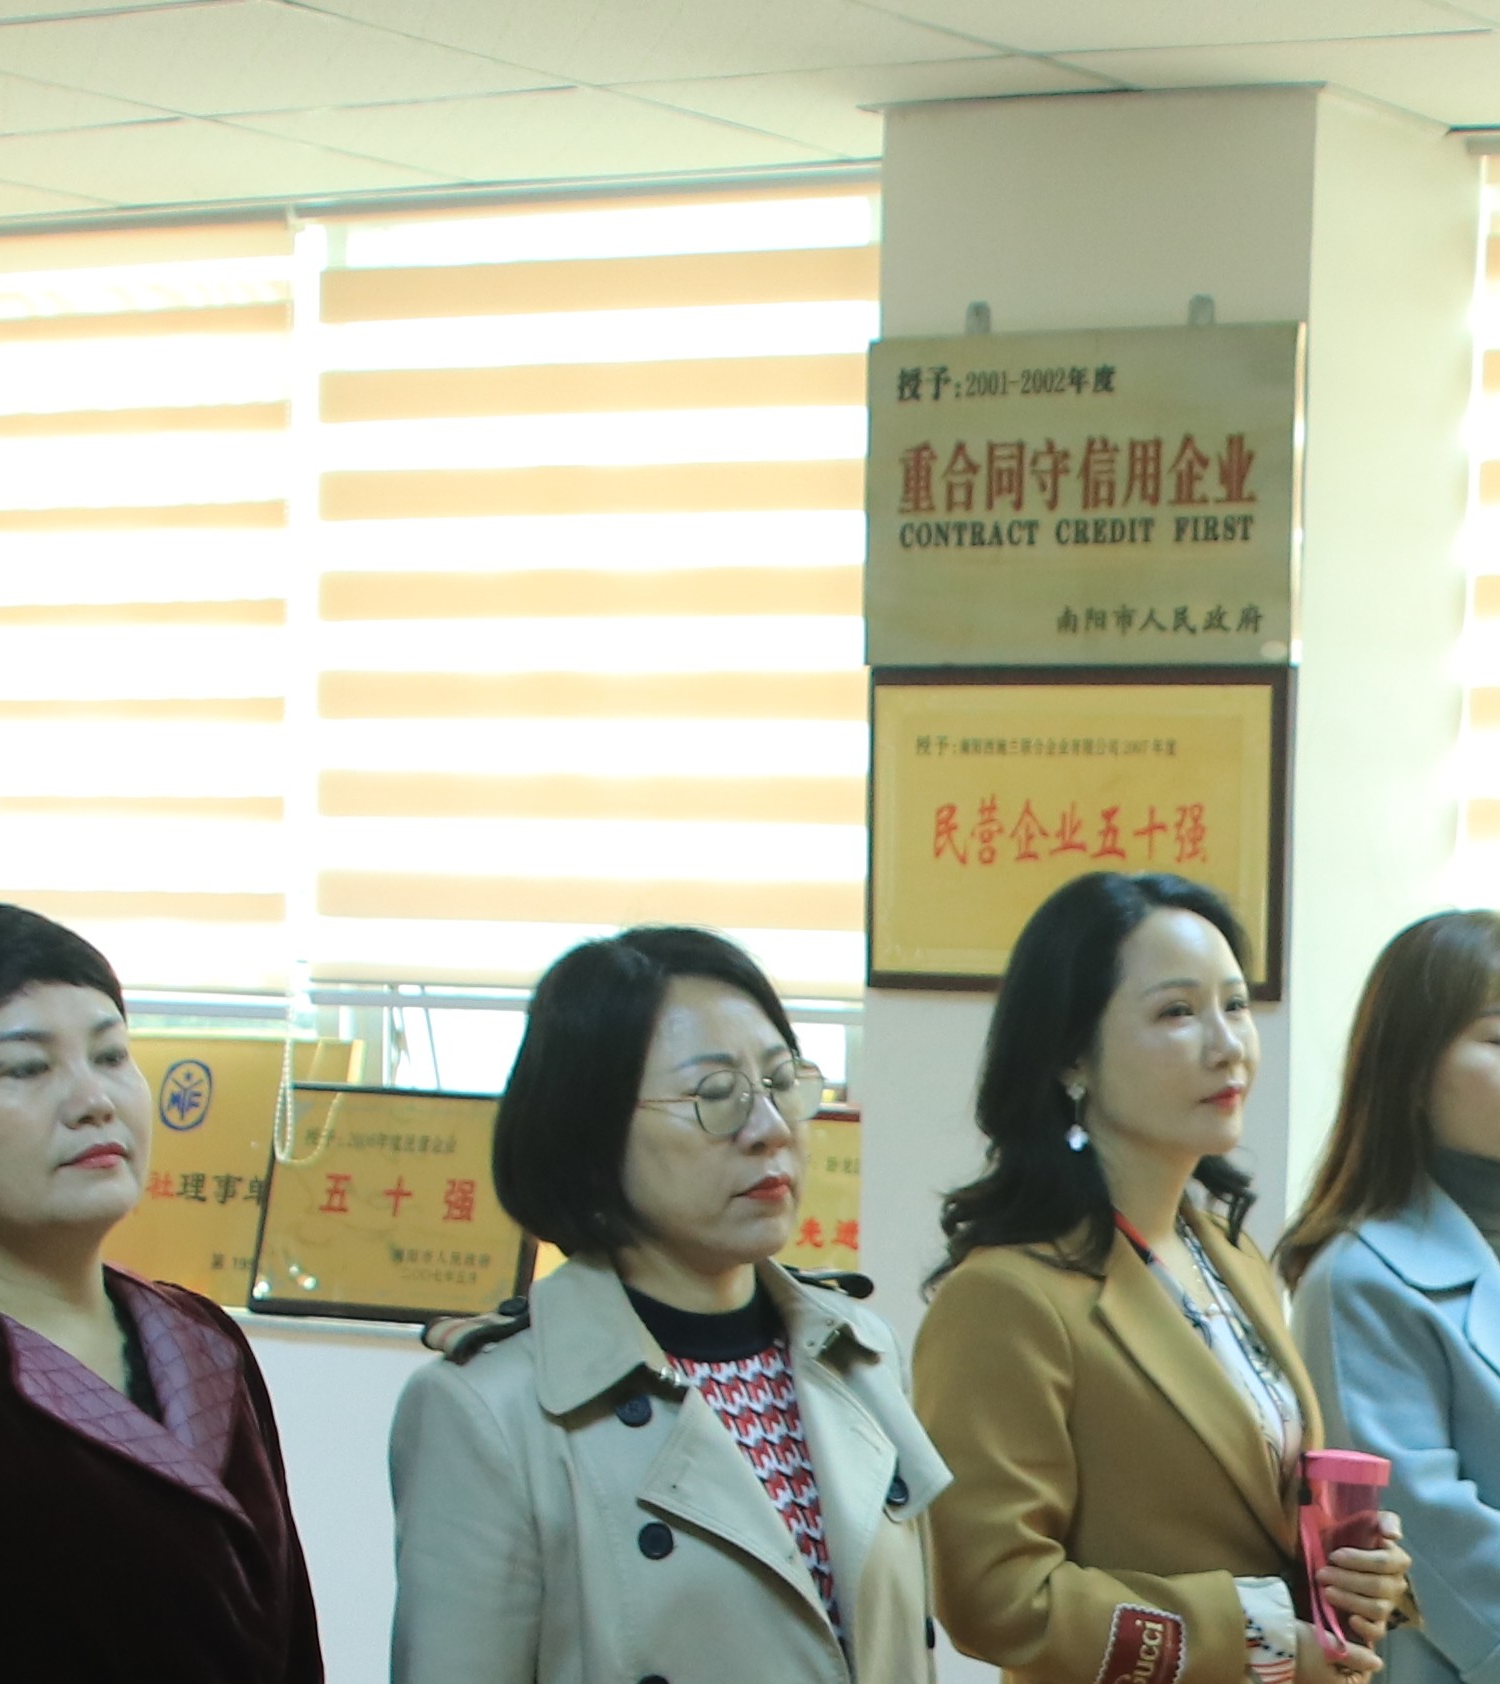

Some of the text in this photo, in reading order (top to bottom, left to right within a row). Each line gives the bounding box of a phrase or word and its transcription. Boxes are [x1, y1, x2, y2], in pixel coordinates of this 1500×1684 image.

[899, 433, 1258, 515] 重合同守信用企业
[900, 514, 1255, 549] CONTRACT CREDIT FIRST
[1056, 603, 1264, 636] 南阳市人民政府
[933, 793, 1209, 866] 民营企业五十强
[319, 1172, 476, 1222] 五十强
[796, 1216, 860, 1251] 先进
